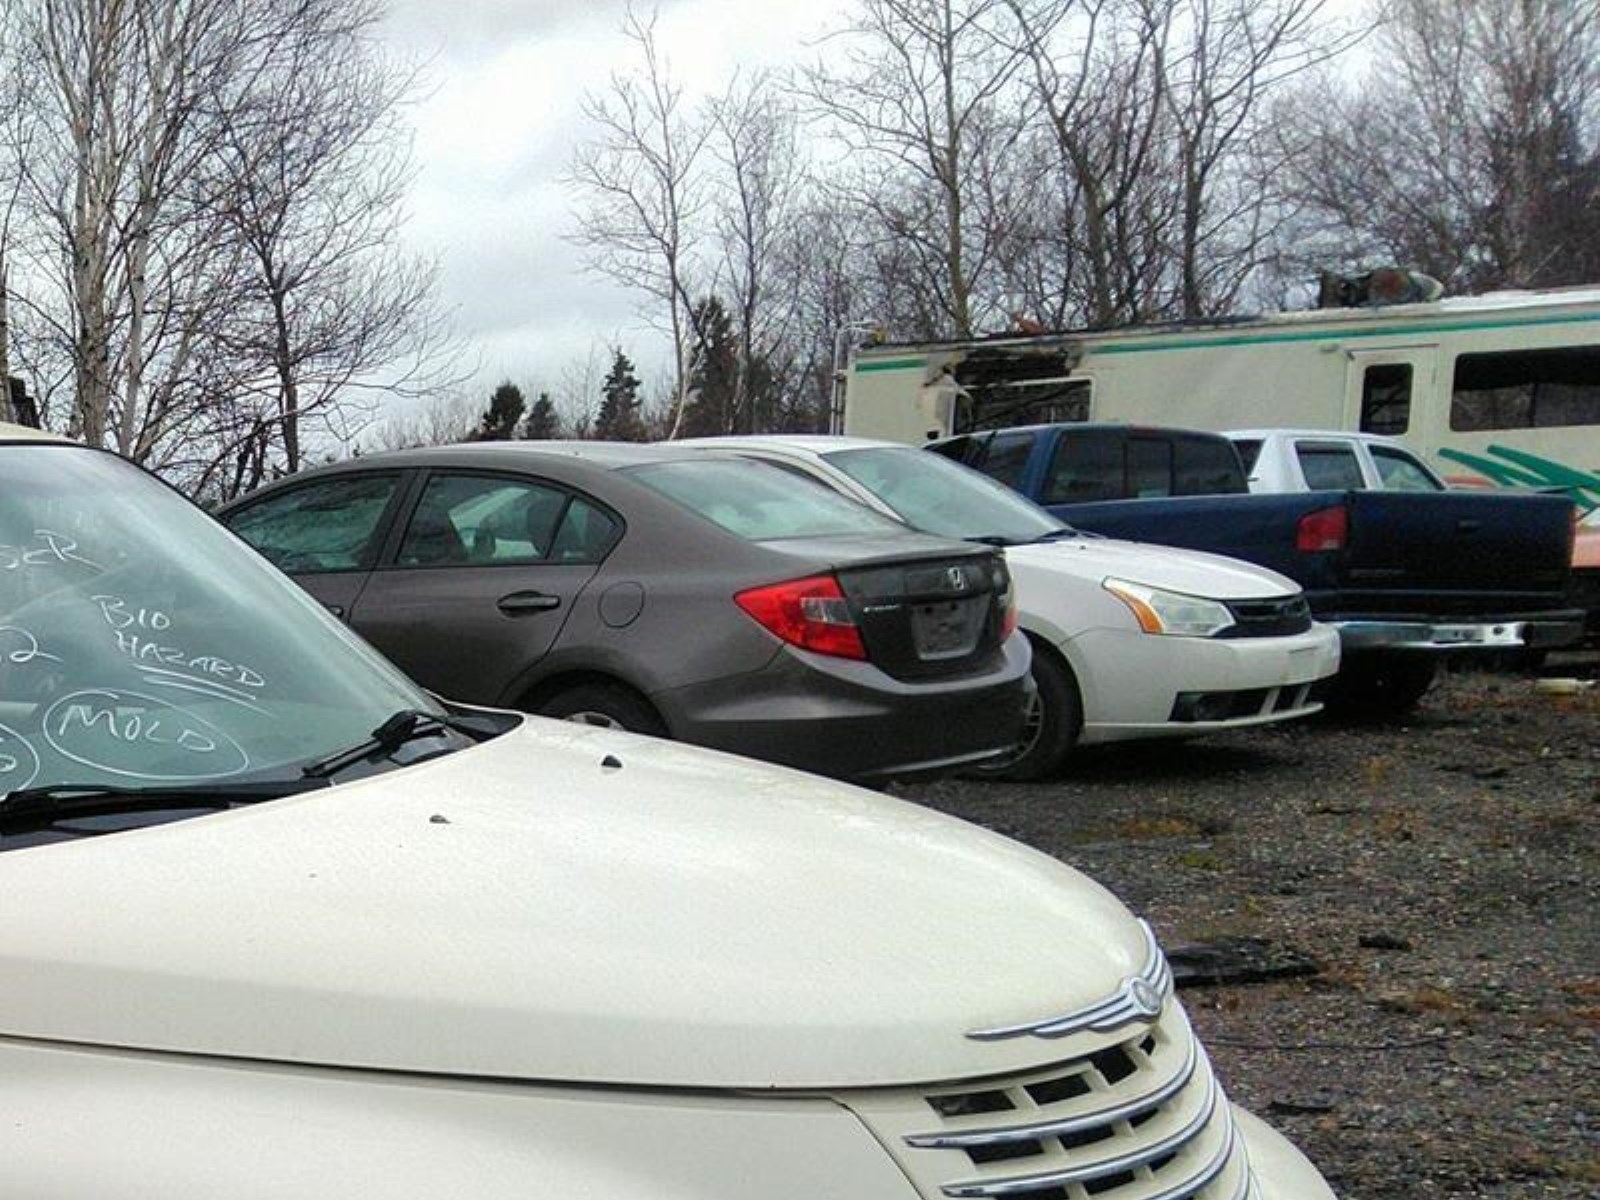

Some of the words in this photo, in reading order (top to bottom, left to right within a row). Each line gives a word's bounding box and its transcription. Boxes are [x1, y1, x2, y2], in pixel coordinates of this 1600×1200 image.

[91, 594, 171, 631] BIO
[114, 629, 265, 687] HAZARD
[58, 704, 216, 752] MOLD
